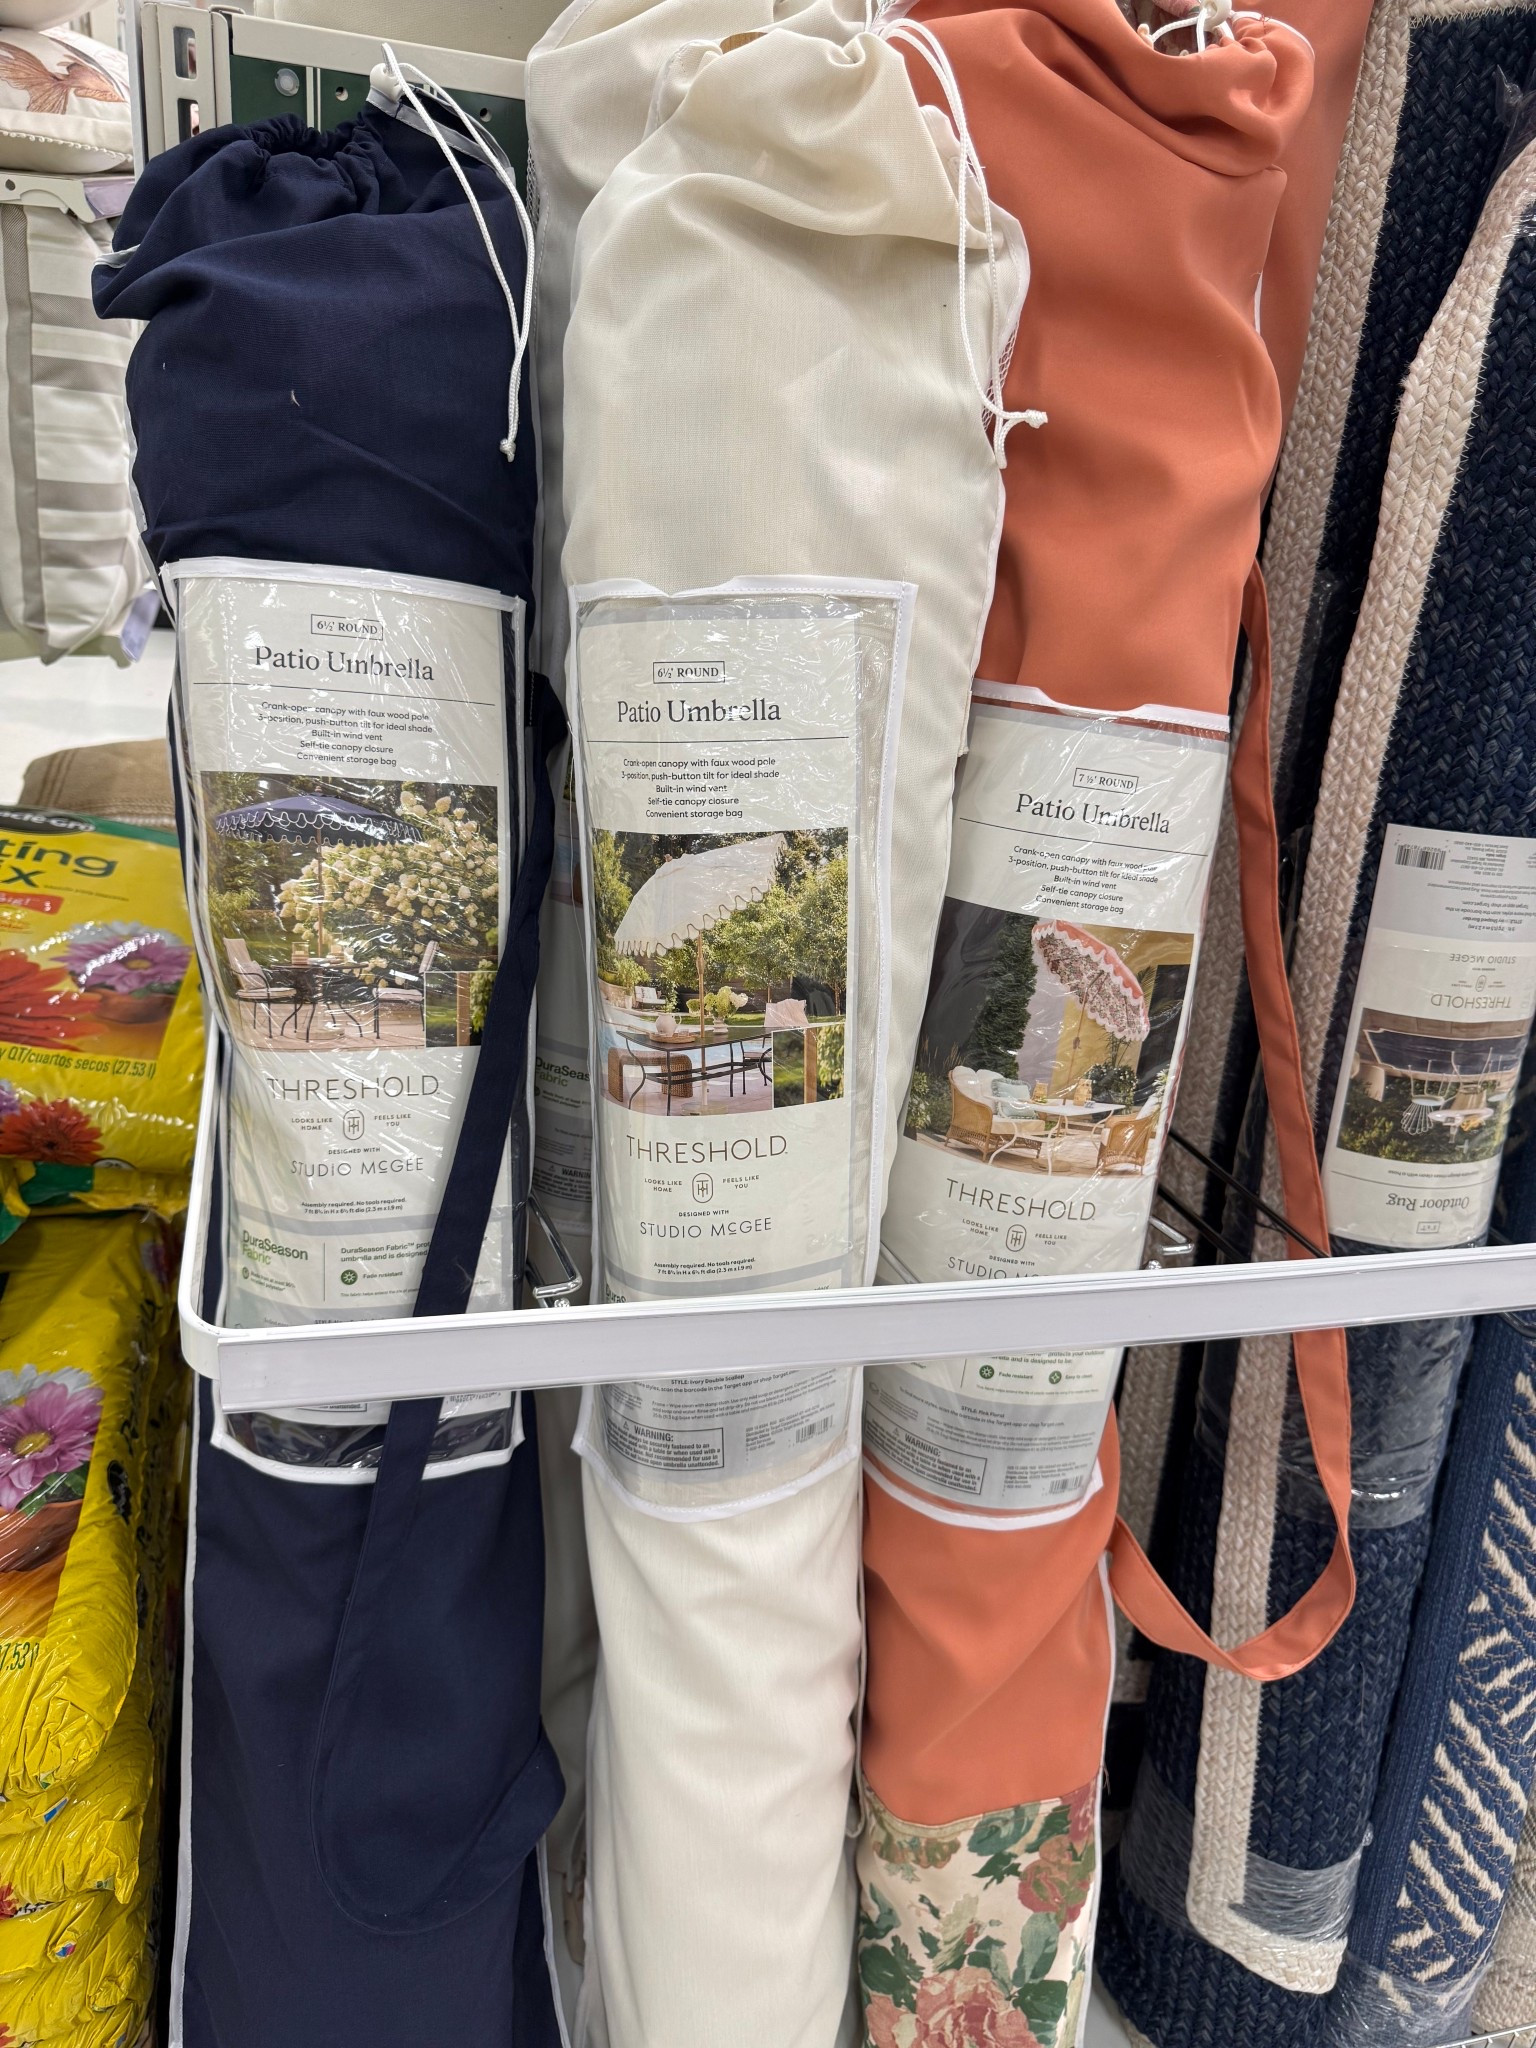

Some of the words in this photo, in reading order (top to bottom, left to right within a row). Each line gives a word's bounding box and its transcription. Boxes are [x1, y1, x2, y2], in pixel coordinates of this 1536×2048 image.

[338, 622, 377, 634] ROUND
[256, 646, 320, 670] Patio
[328, 652, 434, 680] Umbrella
[678, 668, 718, 677] ROUND
[315, 707, 346, 716] canopy
[348, 708, 366, 716] with
[368, 709, 385, 717] faux
[387, 712, 409, 720] wood
[617, 701, 660, 723] Patio
[667, 698, 781, 722] Umbrella
[306, 718, 358, 727] push-button
[373, 721, 384, 729] for
[386, 723, 407, 731] ideal
[312, 730, 341, 738] Built-in
[343, 732, 363, 740] wind
[300, 741, 329, 750] Self-tie
[331, 744, 362, 753] canopy
[365, 745, 393, 753] closure
[297, 753, 344, 762] Convenient
[346, 756, 378, 765] storage
[380, 758, 397, 766] bag
[624, 759, 656, 768] Crank-open
[658, 760, 688, 769] canopy
[691, 759, 708, 767] with
[711, 758, 729, 767] faux
[731, 758, 755, 766] wood
[757, 757, 775, 767] pole
[622, 771, 650, 781] 3-position,
[652, 773, 700, 781] push-button
[717, 771, 728, 779] for
[754, 770, 779, 778] shade
[1099, 777, 1133, 789] ROUND
[675, 798, 706, 806] canopy
[709, 797, 739, 805] closure
[646, 810, 688, 818] Convenient
[690, 810, 724, 819] storage
[726, 809, 742, 818] bag
[1016, 793, 1075, 820] Patio
[1082, 803, 1170, 833] Umbrella
[0, 839, 119, 877] ting
[1014, 846, 1059, 860] Crank-open
[1062, 855, 1089, 865] canopy
[1092, 858, 1106, 866] with
[1108, 859, 1122, 867] faux
[1009, 856, 1049, 870] 3-position,
[1050, 864, 1097, 876] push-button
[1122, 872, 1138, 881] ideal
[1139, 875, 1158, 883] shade
[1054, 875, 1080, 886] Built-in
[1082, 879, 1099, 887] wind
[1041, 885, 1068, 895] Self-tie
[1070, 890, 1097, 900] canopy
[1099, 893, 1123, 901] closure
[1036, 895, 1079, 908] Convenient
[1081, 901, 1108, 912] storage
[1487, 956, 1516, 964] STUDIO
[1430, 994, 1512, 1009] THRESHOLD
[8, 1046, 72, 1068] QT/cuartos
[75, 1058, 110, 1072] secos
[112, 1059, 147, 1076] (27.53
[535, 1057, 590, 1081] DuraSeas
[267, 1075, 440, 1100] THRESHOLD
[626, 1135, 788, 1163] THRESHOLD
[291, 1161, 351, 1177] STUDIO
[947, 1178, 1096, 1221] THRESHOLD
[1386, 1193, 1417, 1211] Rug
[1420, 1197, 1470, 1211] Outdoor
[640, 1221, 702, 1238] STUDIO
[962, 1219, 983, 1229] LOOKS
[970, 1227, 989, 1236] HOME
[243, 1230, 308, 1260] DuraSeason
[243, 1243, 271, 1265] Fabric
[989, 1255, 1018, 1265] DESIGNED
[948, 1257, 1006, 1279] STUDIO
[724, 1382, 741, 1390] Target
[634, 1425, 674, 1441] WARNING:
[905, 1433, 941, 1457] WARNING:
